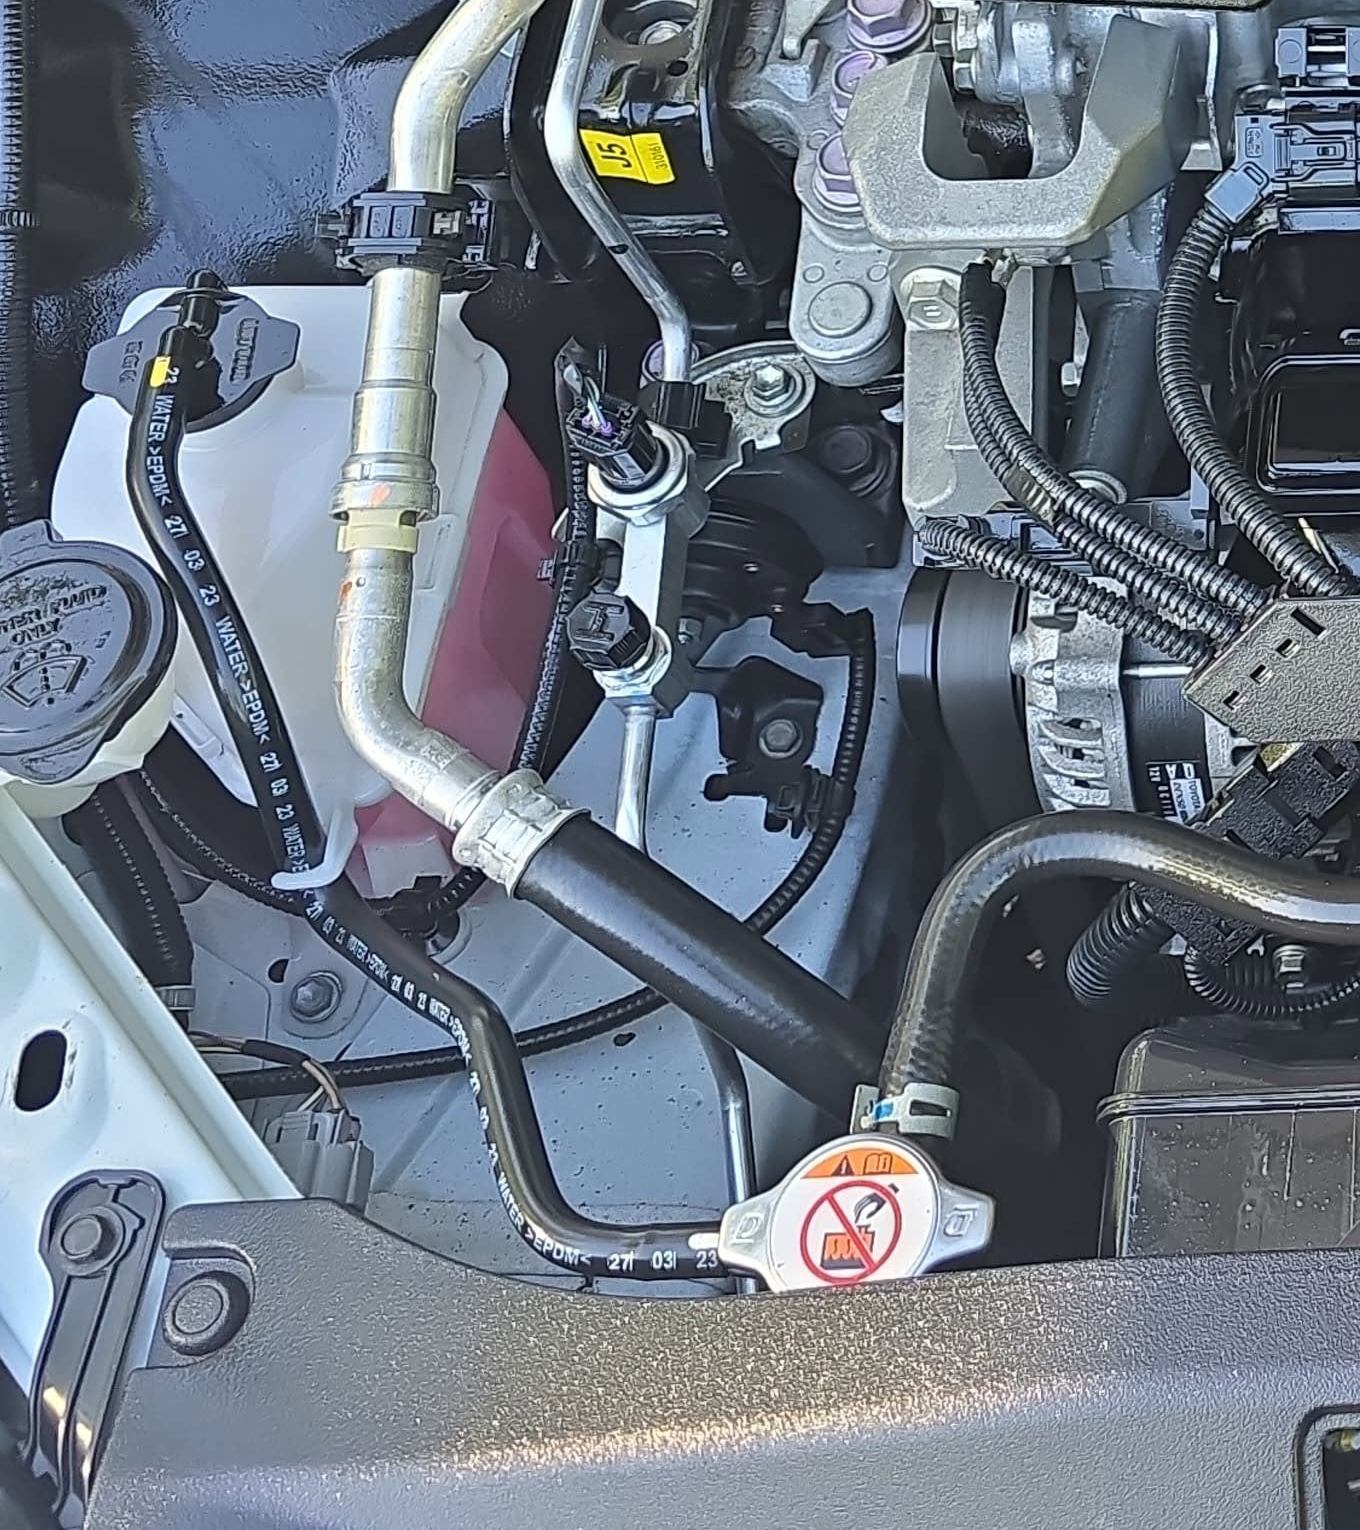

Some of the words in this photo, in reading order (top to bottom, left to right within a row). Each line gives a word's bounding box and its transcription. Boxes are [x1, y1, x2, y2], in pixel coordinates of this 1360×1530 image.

[596, 141, 633, 169] J5
[148, 393, 175, 442] WATER
[145, 446, 173, 507] >EPDM<
[199, 584, 220, 607] 23
[216, 616, 249, 676] WATER
[238, 676, 271, 745] >EPDM<
[276, 805, 293, 819] 23
[282, 823, 306, 862] WATER
[497, 1171, 526, 1232] WATER
[523, 1223, 592, 1268] >EPDM<
[696, 1250, 720, 1269] 23
